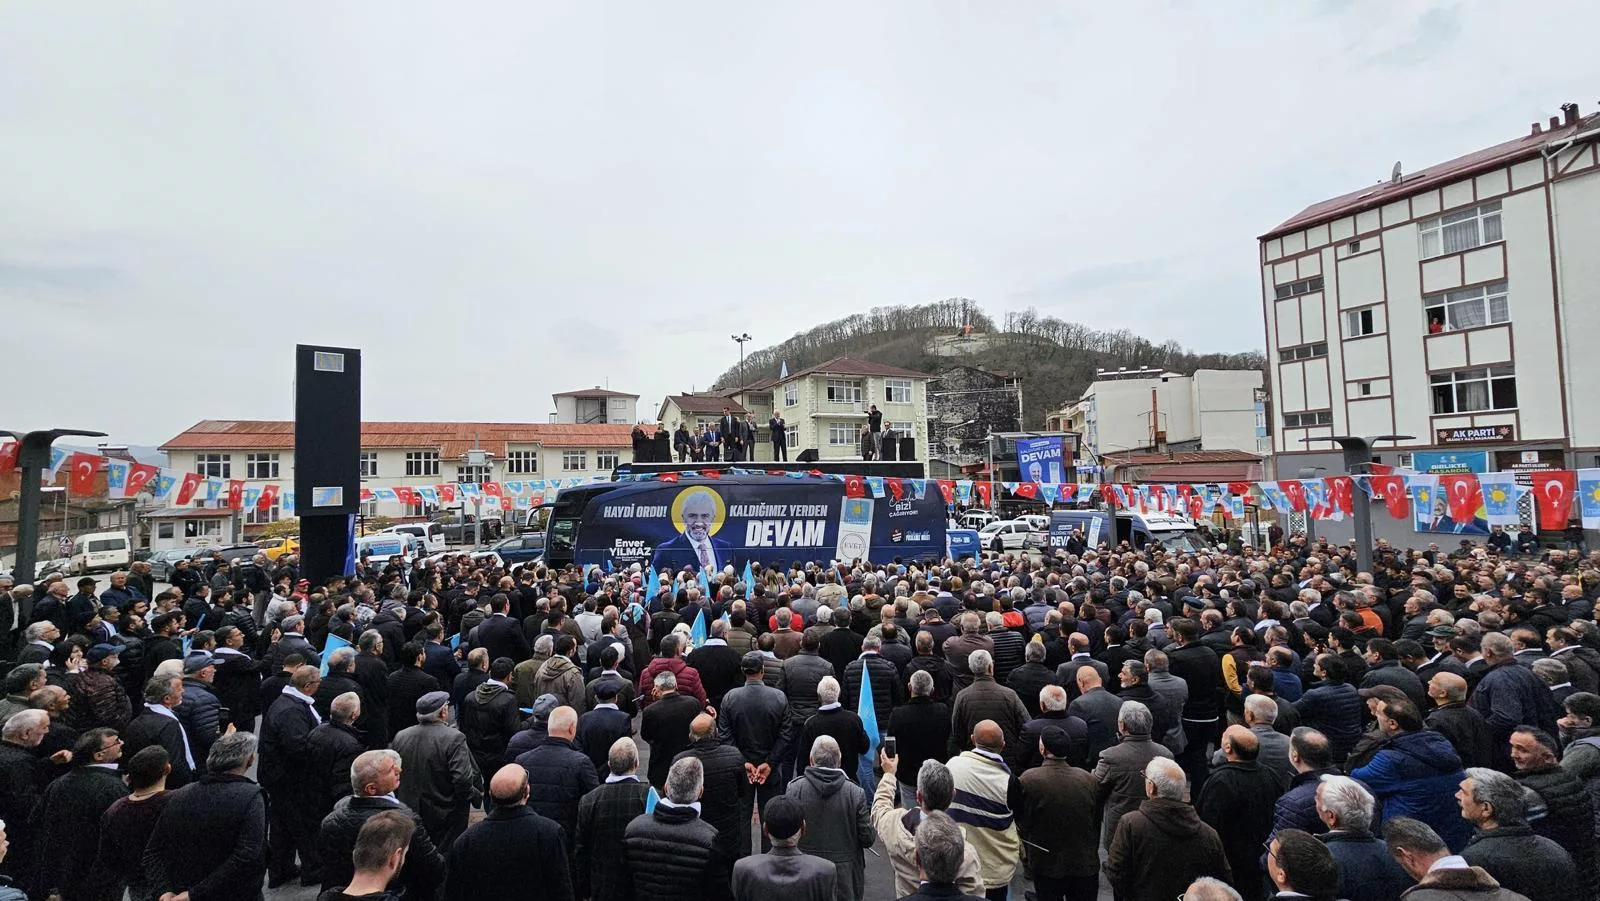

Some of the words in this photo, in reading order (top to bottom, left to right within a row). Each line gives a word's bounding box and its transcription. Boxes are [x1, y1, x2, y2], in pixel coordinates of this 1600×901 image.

[1453, 430, 1466, 438] AK
[1467, 427, 1495, 438] PARTİ
[1021, 448, 1061, 463] DEVAM
[603, 503, 635, 518] HAYDİ
[636, 505, 668, 518] ORDU!
[729, 502, 788, 517] KALDIĞIMIZ
[789, 504, 828, 517] YERDEN
[895, 501, 912, 511] BİZİ
[745, 519, 826, 547] DEVAM
[615, 538, 645, 548] Enver
[609, 547, 652, 556] YILMAZ
